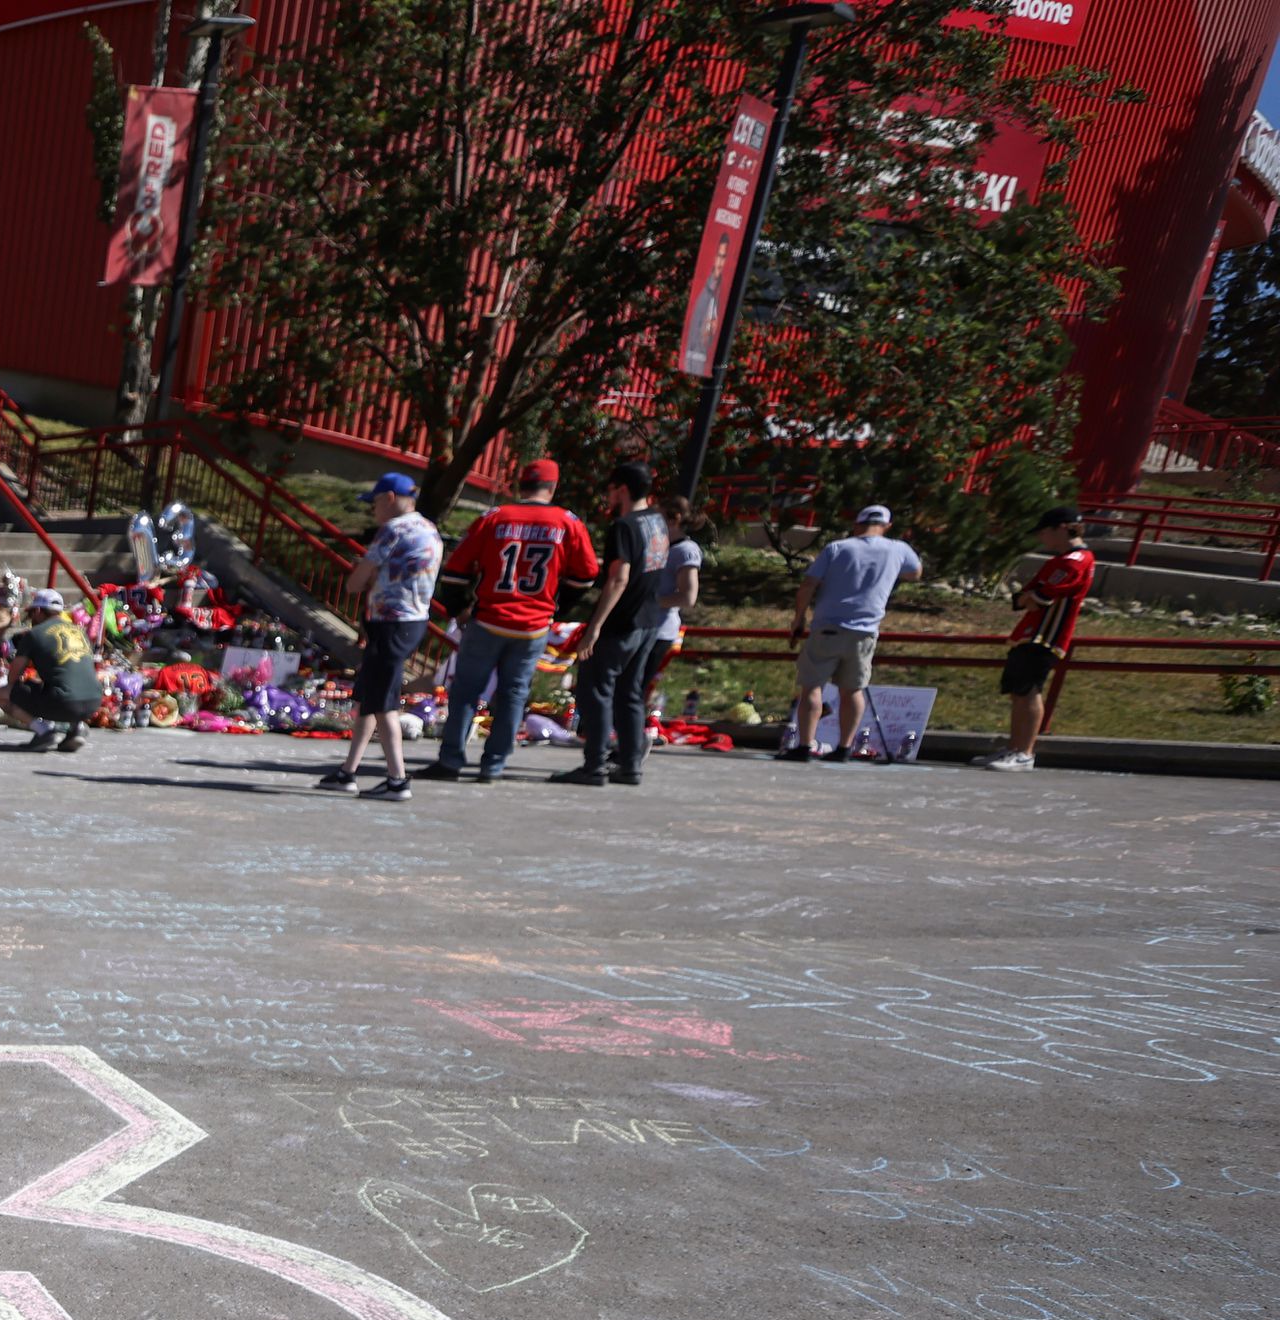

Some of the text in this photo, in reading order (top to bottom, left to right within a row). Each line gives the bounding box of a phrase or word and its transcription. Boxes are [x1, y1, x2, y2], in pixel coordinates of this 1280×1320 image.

[145, 121, 167, 178] RED
[494, 541, 556, 595] 13
[502, 962, 1280, 1002] LONG LIVE
